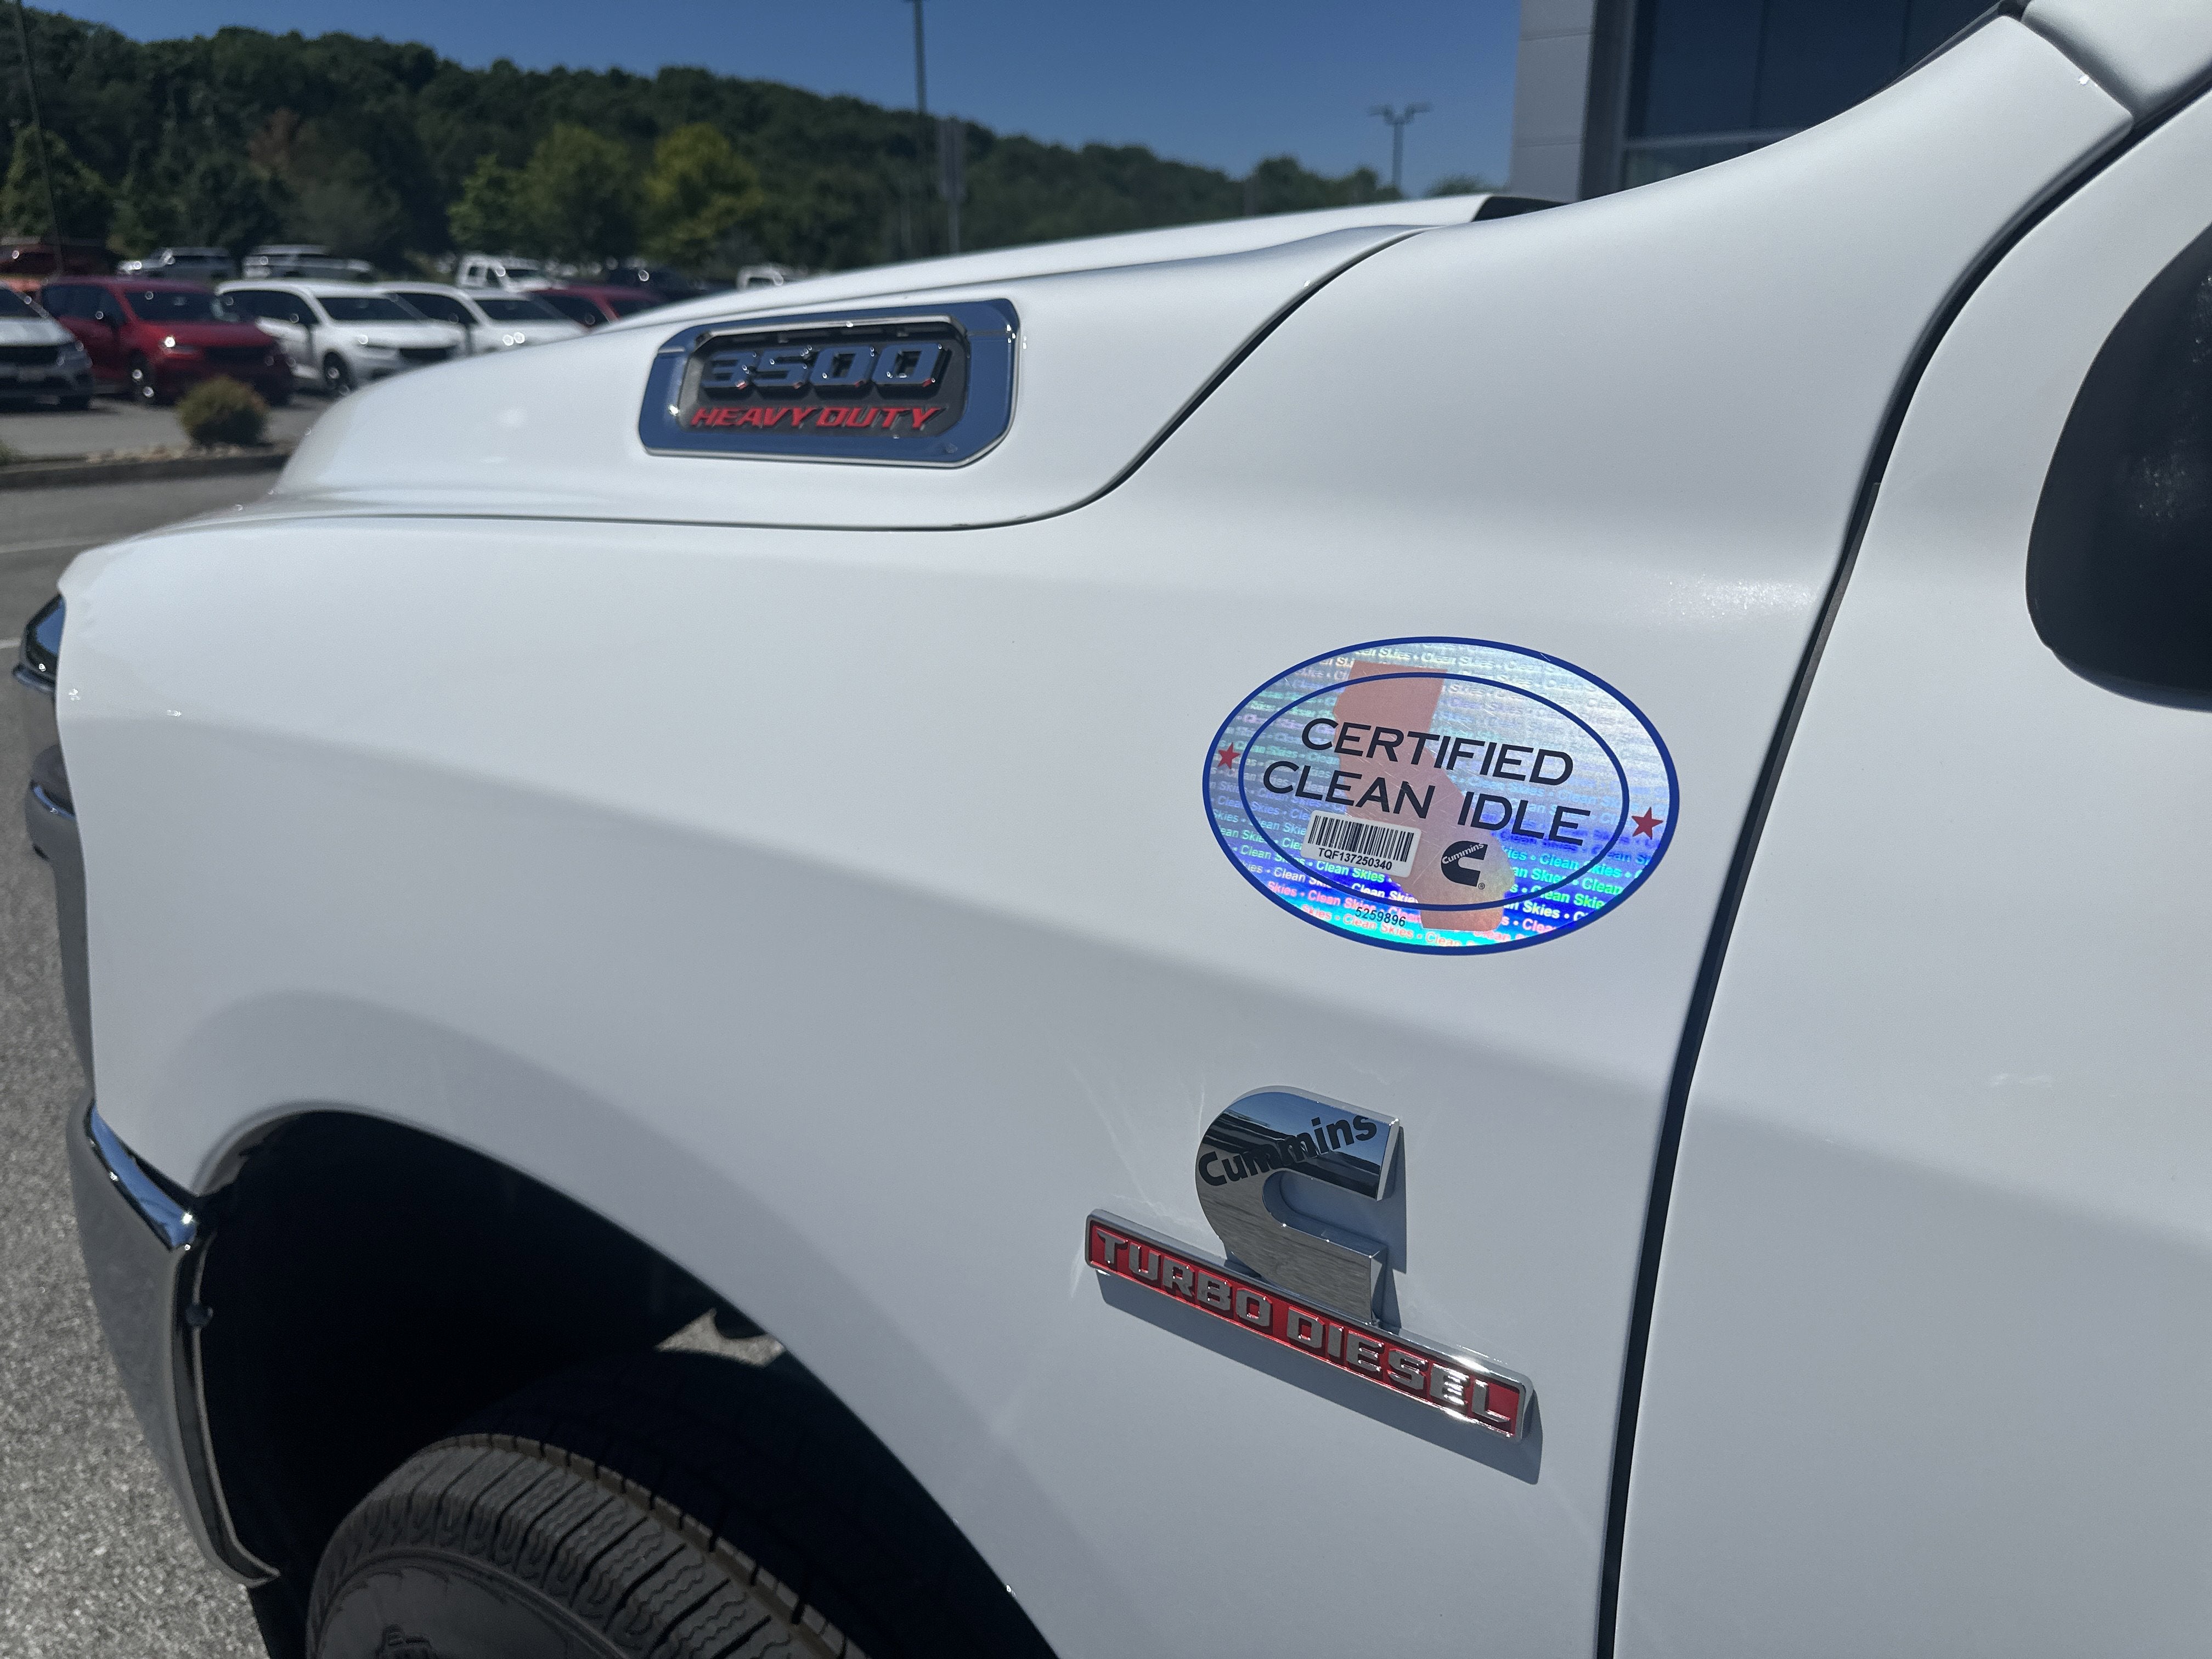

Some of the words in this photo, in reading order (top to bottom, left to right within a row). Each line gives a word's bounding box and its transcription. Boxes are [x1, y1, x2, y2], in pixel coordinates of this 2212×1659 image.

[702, 341, 945, 391] 3500
[690, 405, 817, 428] HEAVY
[816, 405, 943, 430] DUTY
[1234, 740, 1266, 754] Clan
[1302, 717, 1573, 786] CERTIFIED
[1263, 760, 1435, 819] CLEAN
[1457, 791, 1590, 846] IDLE
[1290, 808, 1311, 821] Cle
[1218, 825, 1239, 838] ean
[1242, 829, 1265, 843] Skie
[1282, 837, 1302, 850] Cle
[1249, 816, 1280, 831] lean
[1283, 822, 1307, 836] Skie
[1241, 844, 1272, 860] Clean
[1317, 860, 1350, 876] Clean
[1352, 867, 1386, 883] Skies
[1318, 847, 1392, 871] TQF137250340
[1442, 843, 1484, 864] Cummins
[1539, 853, 1580, 871] Clean
[1584, 860, 1622, 878] kies
[1274, 867, 1306, 883] Clean
[1531, 867, 1567, 884] Skie
[1267, 881, 1297, 897] Skies
[1307, 889, 1341, 906] Clean
[1573, 893, 1606, 910] Skie
[1355, 906, 1406, 927] 5259896
[1522, 900, 1561, 919] Skies
[1343, 913, 1377, 931] Clean
[1380, 922, 1414, 939] Skies
[1522, 918, 1557, 933] Cle
[1198, 1114, 1377, 1187] Cummins
[1097, 1228, 1273, 1329] TURBO
[1287, 1307, 1511, 1423] DIESEL
